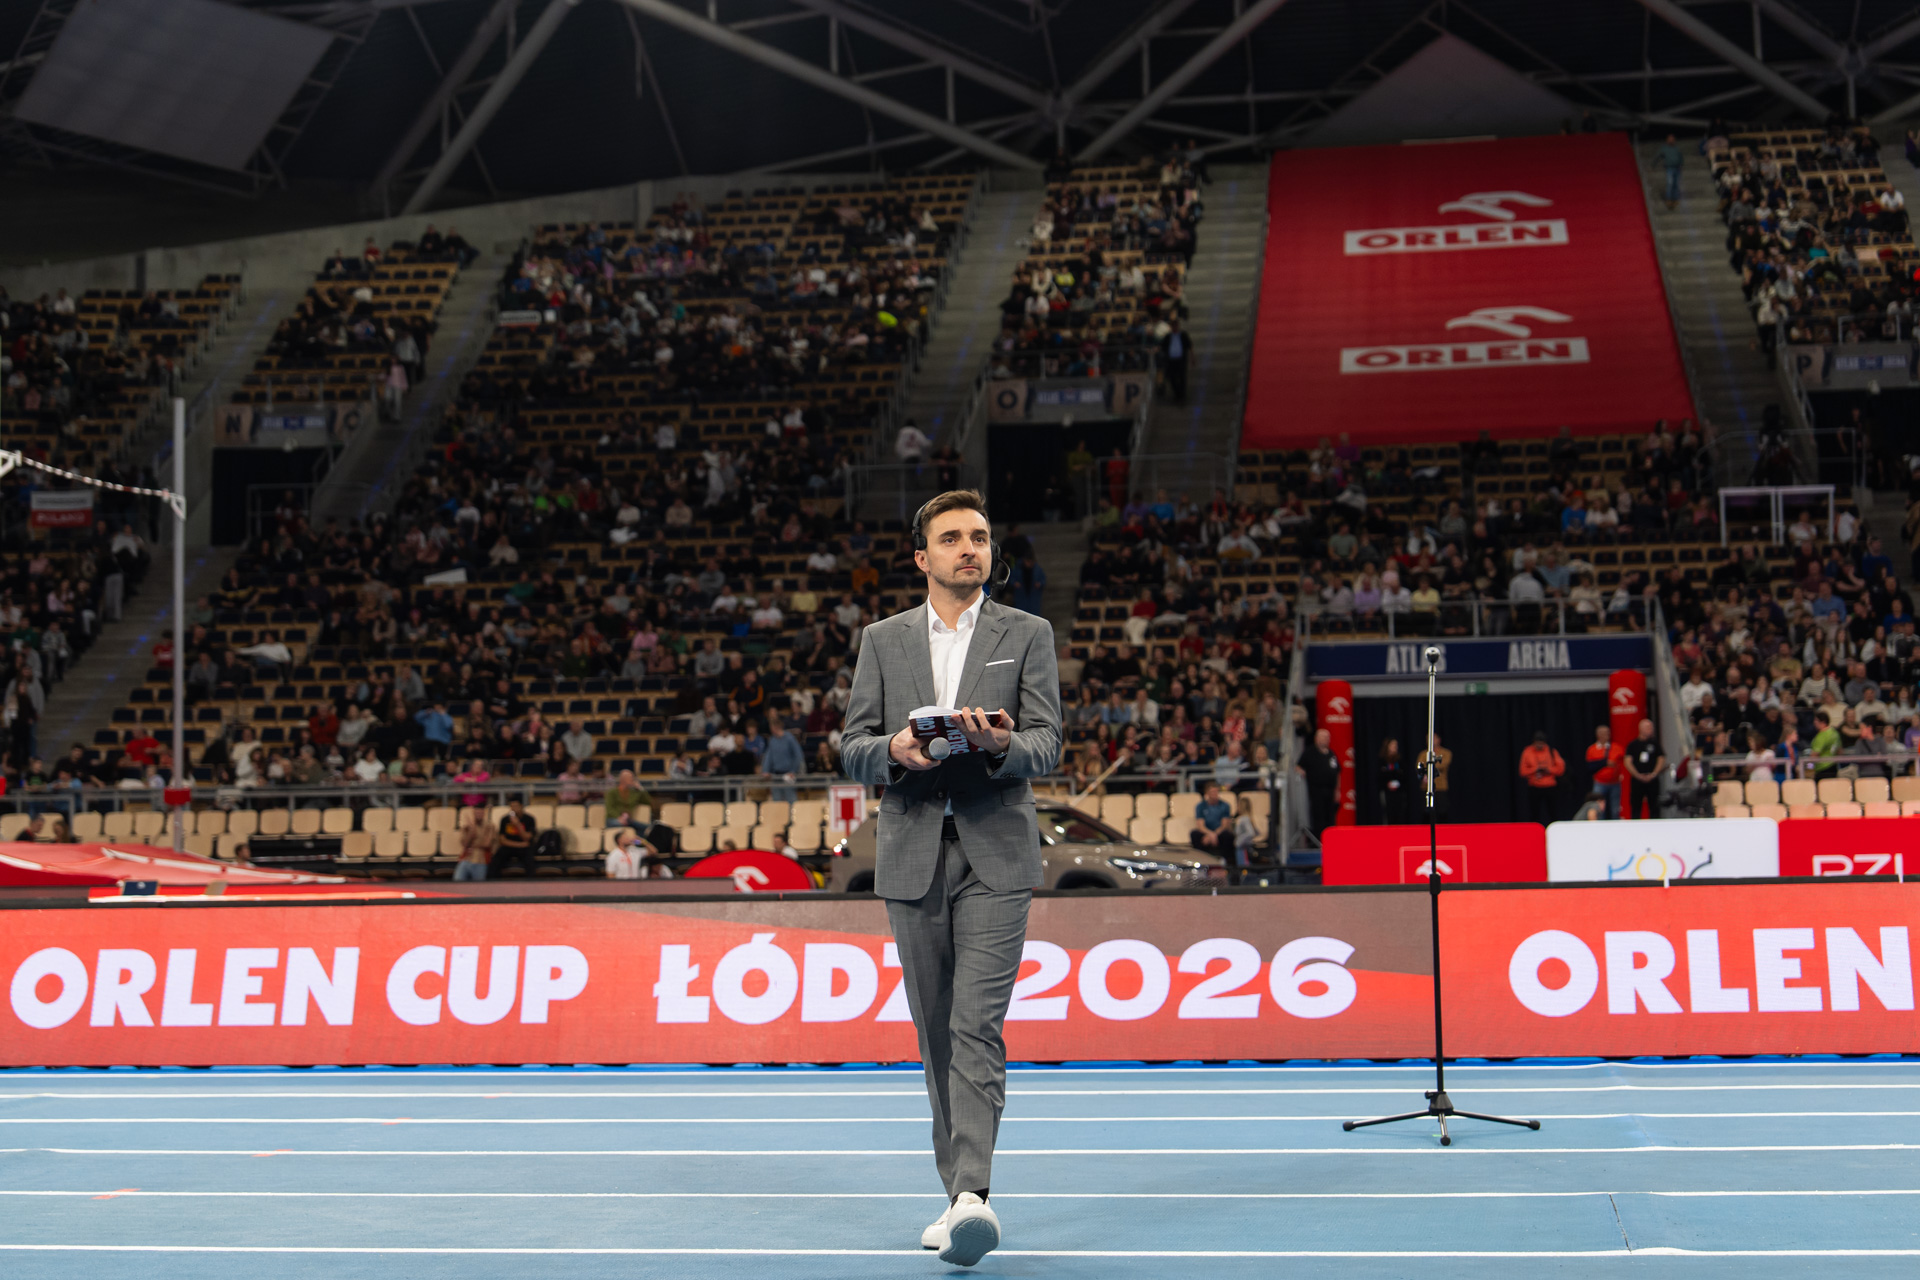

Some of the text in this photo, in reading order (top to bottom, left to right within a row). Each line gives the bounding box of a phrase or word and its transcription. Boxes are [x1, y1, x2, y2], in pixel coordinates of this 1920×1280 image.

[1357, 223, 1552, 250] ORLEN
[1353, 342, 1573, 369] ORLEN
[1126, 384, 1139, 403] P
[225, 413, 241, 434] N
[1507, 640, 1572, 671] ARENA
[9, 946, 360, 1030] ORLEN
[386, 944, 589, 1026] CUP
[1006, 935, 1357, 1021] 2026
[1508, 925, 1915, 1018] ORLEN
